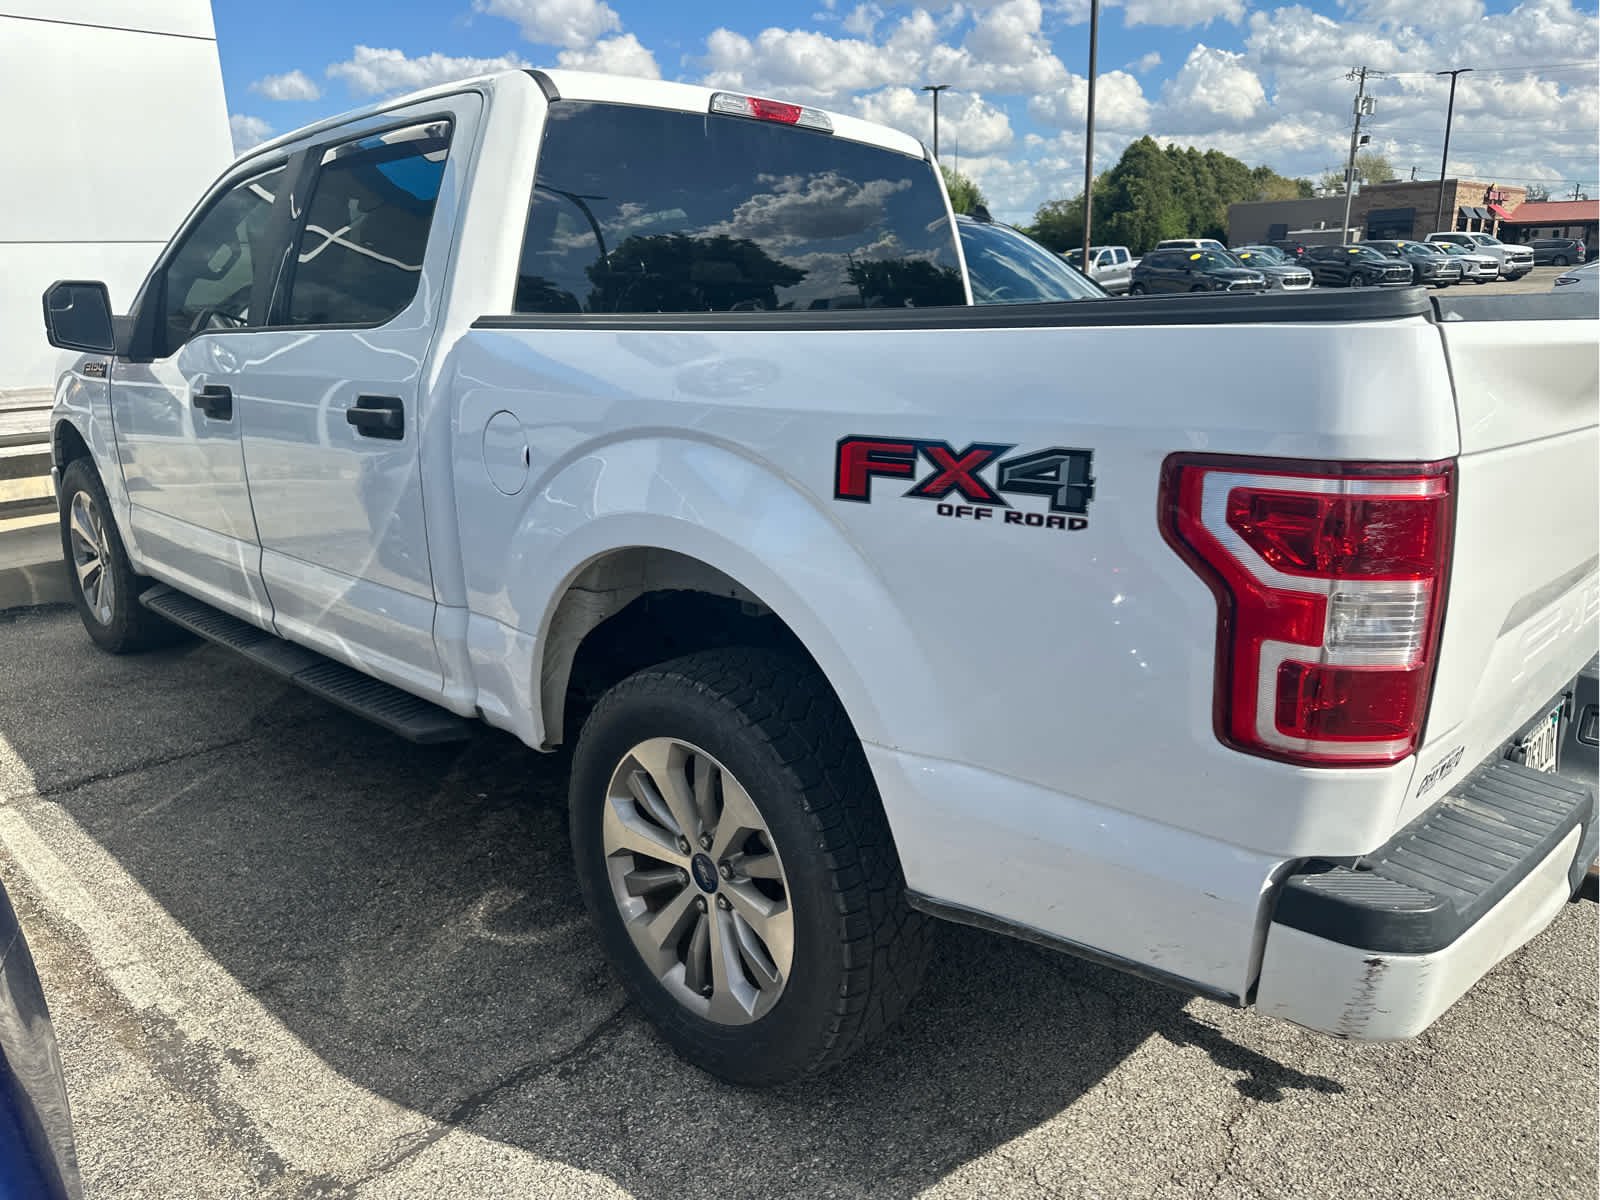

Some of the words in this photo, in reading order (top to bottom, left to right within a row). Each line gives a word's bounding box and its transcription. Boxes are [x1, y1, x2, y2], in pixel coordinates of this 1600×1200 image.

[833, 433, 1095, 516] FX4
[936, 503, 993, 520] OFF
[1004, 509, 1089, 531] ROAD
